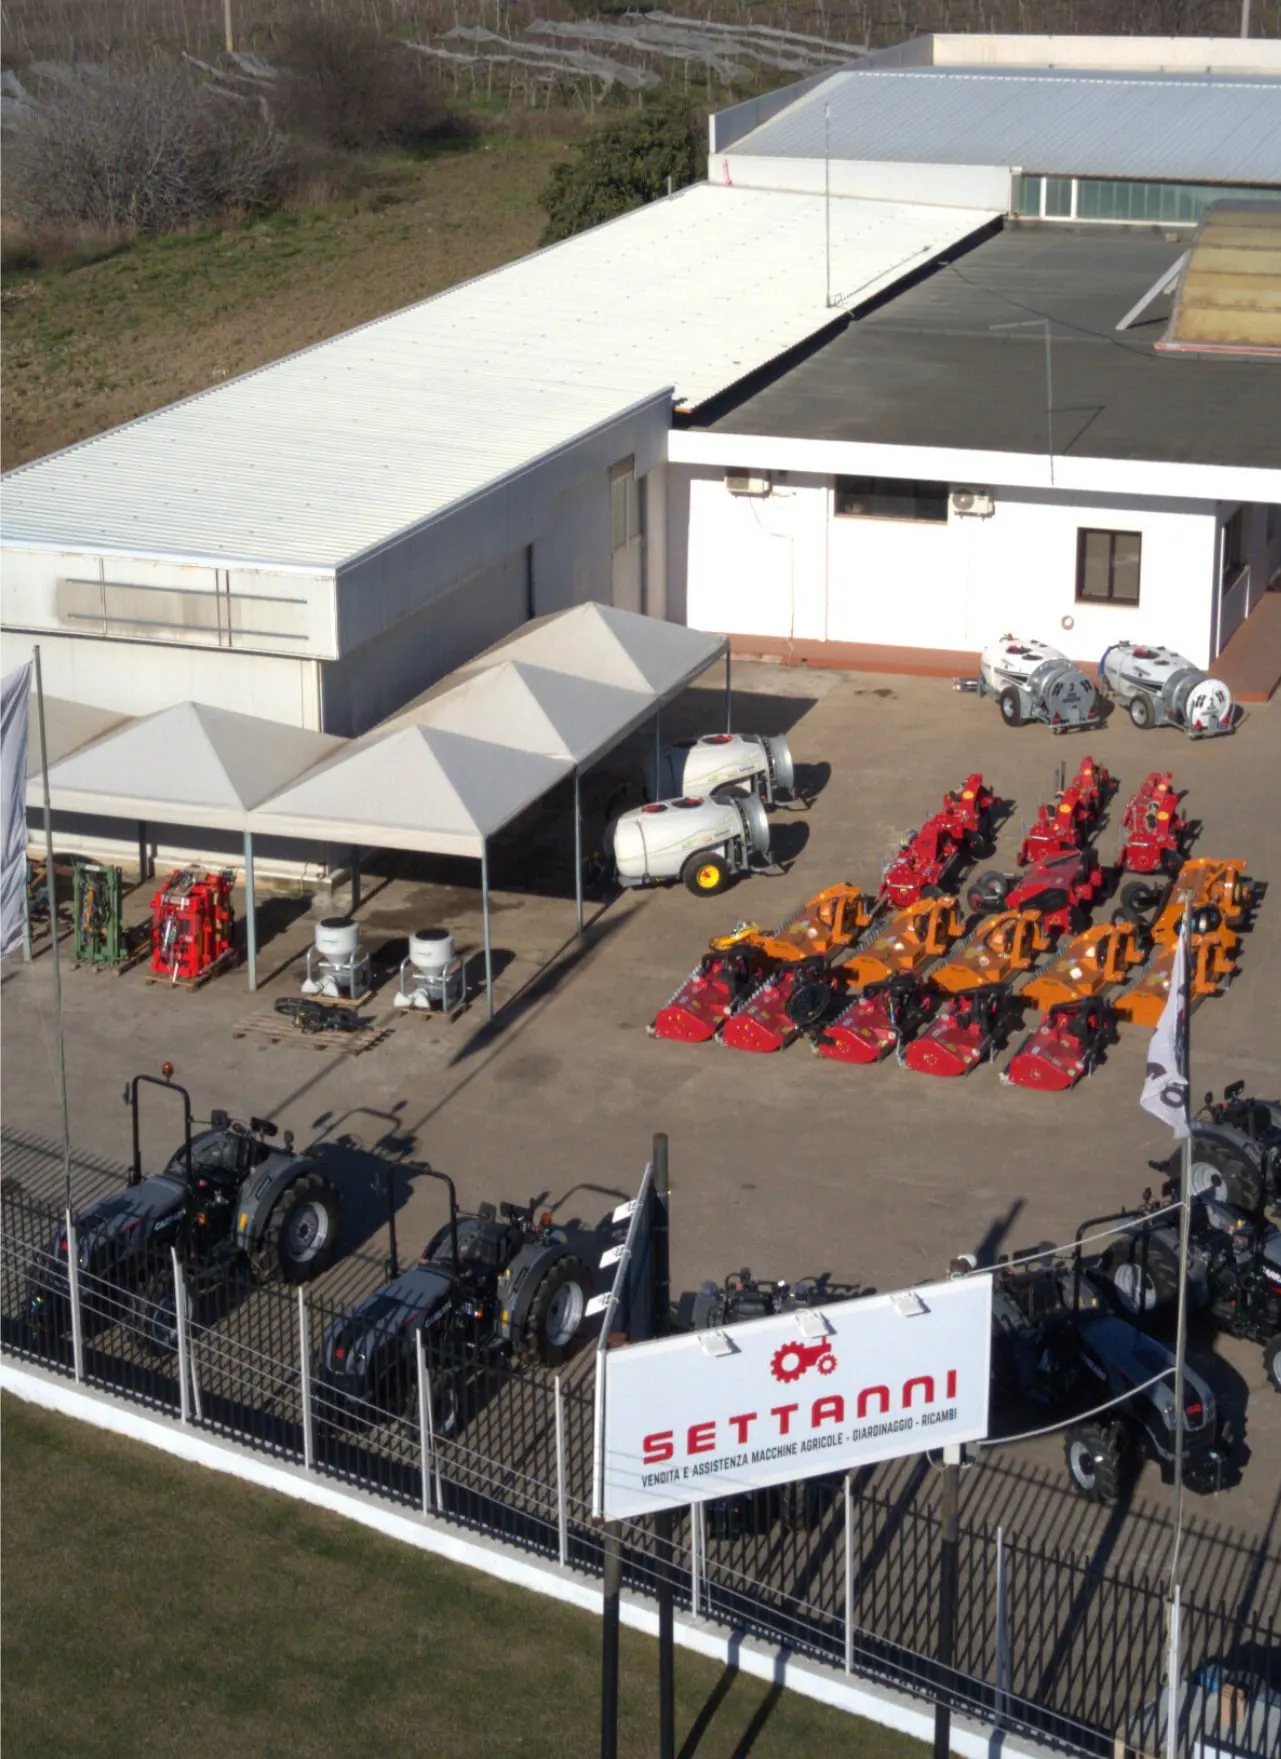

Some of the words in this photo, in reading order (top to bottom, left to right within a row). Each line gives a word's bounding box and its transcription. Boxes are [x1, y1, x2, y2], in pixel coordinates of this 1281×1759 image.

[641, 1467, 680, 1489] VENDITA
[683, 1466, 689, 1479] E
[692, 1453, 748, 1478] ASSISTENZA
[751, 1442, 798, 1464] MACCHINE
[800, 1432, 844, 1453] AGRICOLE
[852, 1417, 914, 1442] GIARDINAGGIO
[922, 1408, 958, 1427] RICAMBI
[642, 1369, 958, 1465] SETTANNI
